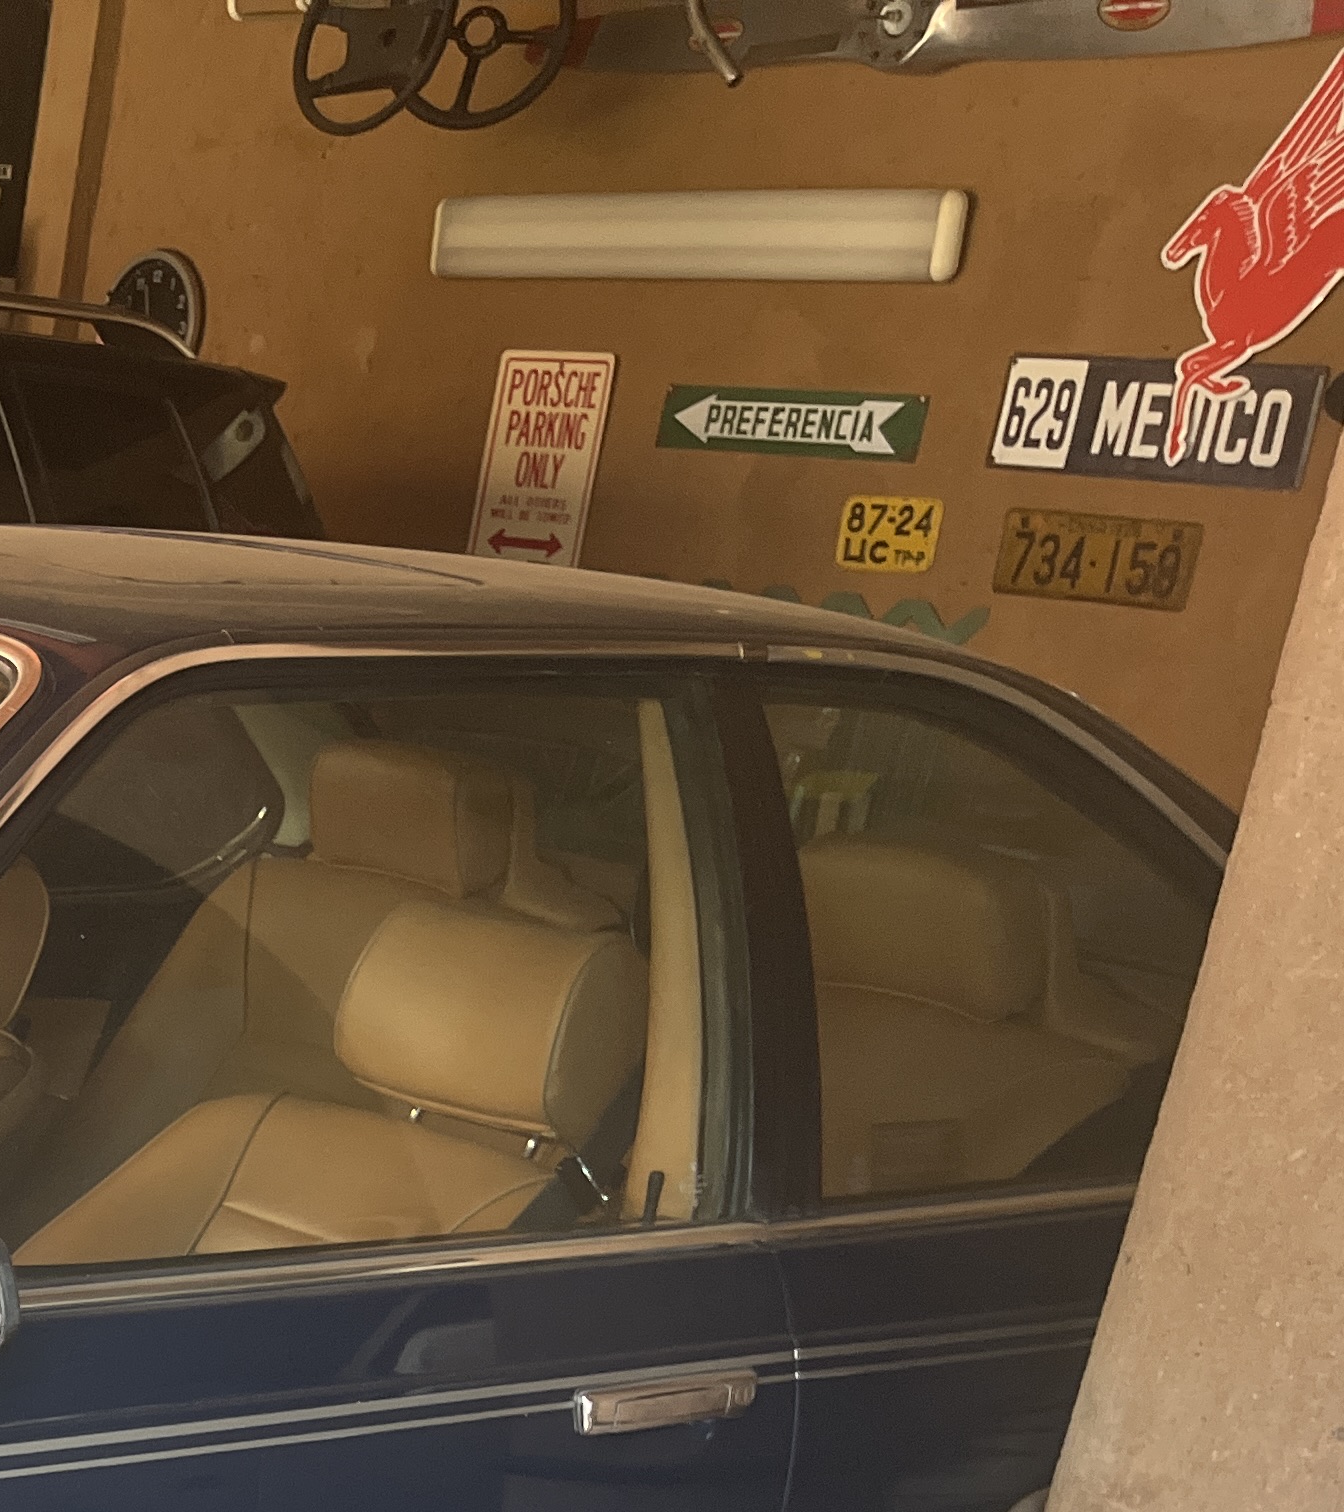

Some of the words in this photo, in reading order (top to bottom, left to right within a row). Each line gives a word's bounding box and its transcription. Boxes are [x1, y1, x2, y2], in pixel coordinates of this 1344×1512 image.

[507, 369, 601, 409] PORSCHE
[504, 410, 589, 450] PARKING
[704, 404, 874, 442] PREFERENCIA
[1001, 376, 1077, 450] 629
[1089, 380, 1293, 469] MEICO
[515, 451, 566, 489] ONLY
